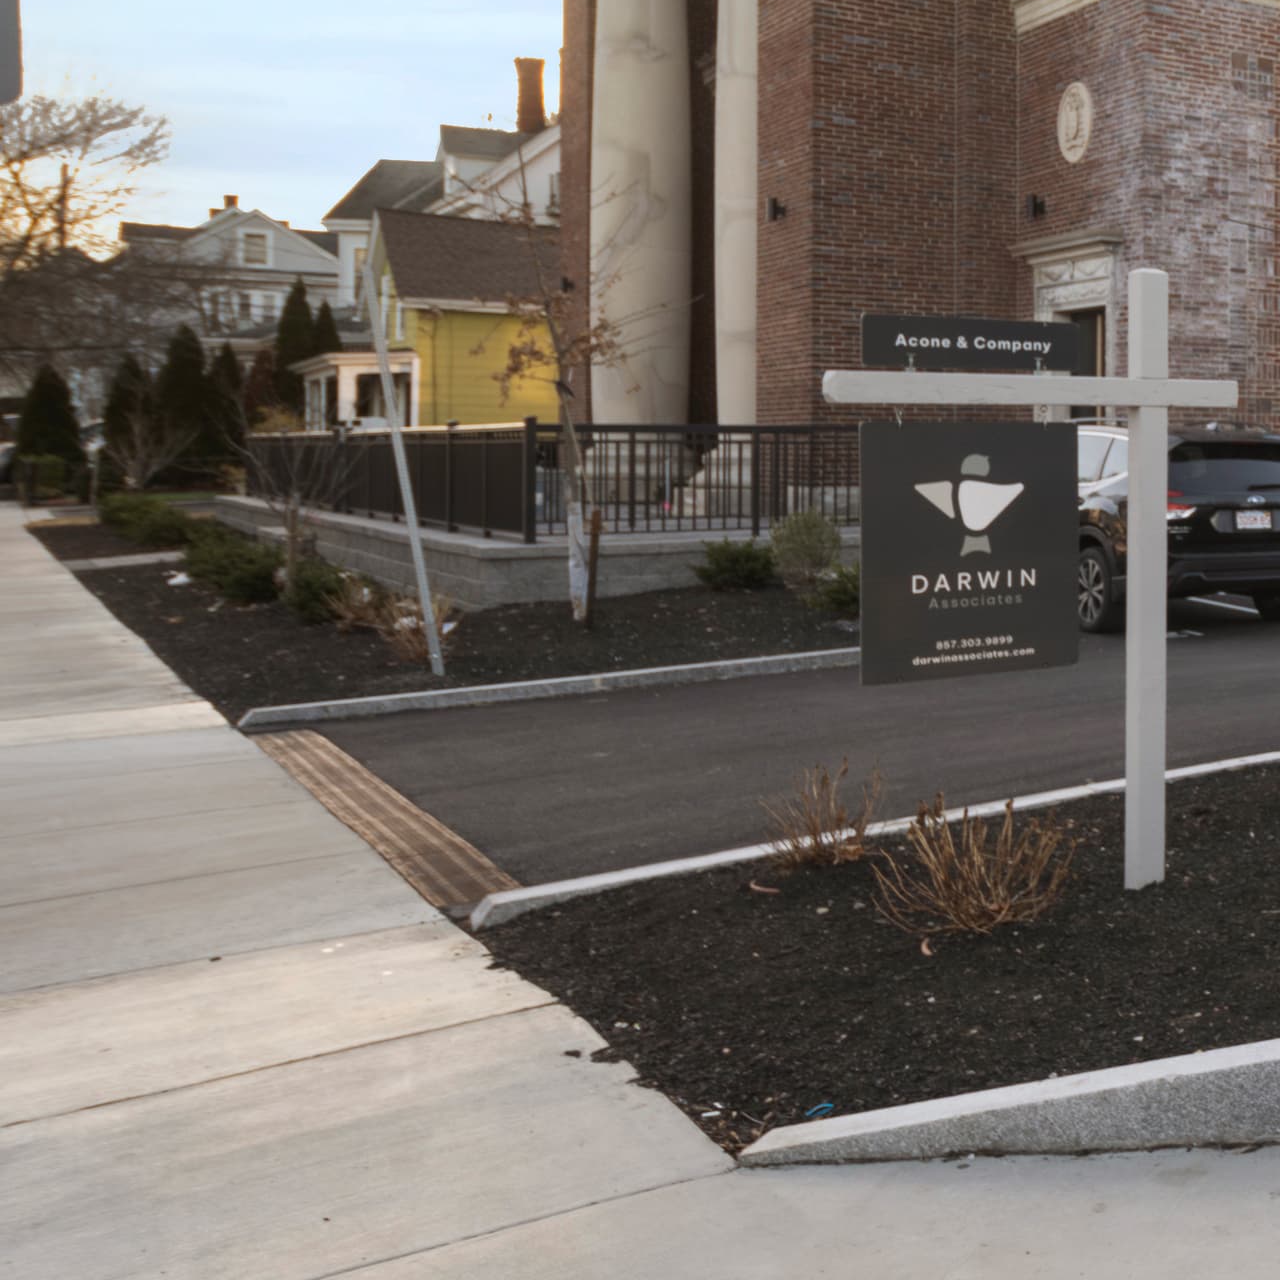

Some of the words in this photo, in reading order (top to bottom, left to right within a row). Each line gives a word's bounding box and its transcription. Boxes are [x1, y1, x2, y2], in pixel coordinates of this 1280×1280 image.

[895, 333, 951, 348] Acone
[956, 335, 968, 349] &
[973, 336, 1051, 354] Company
[911, 568, 1036, 594] DARWIN
[929, 594, 1023, 610] Associates
[936, 635, 1013, 650] 857.303.9899
[912, 647, 1035, 666] darwinassociates.com
